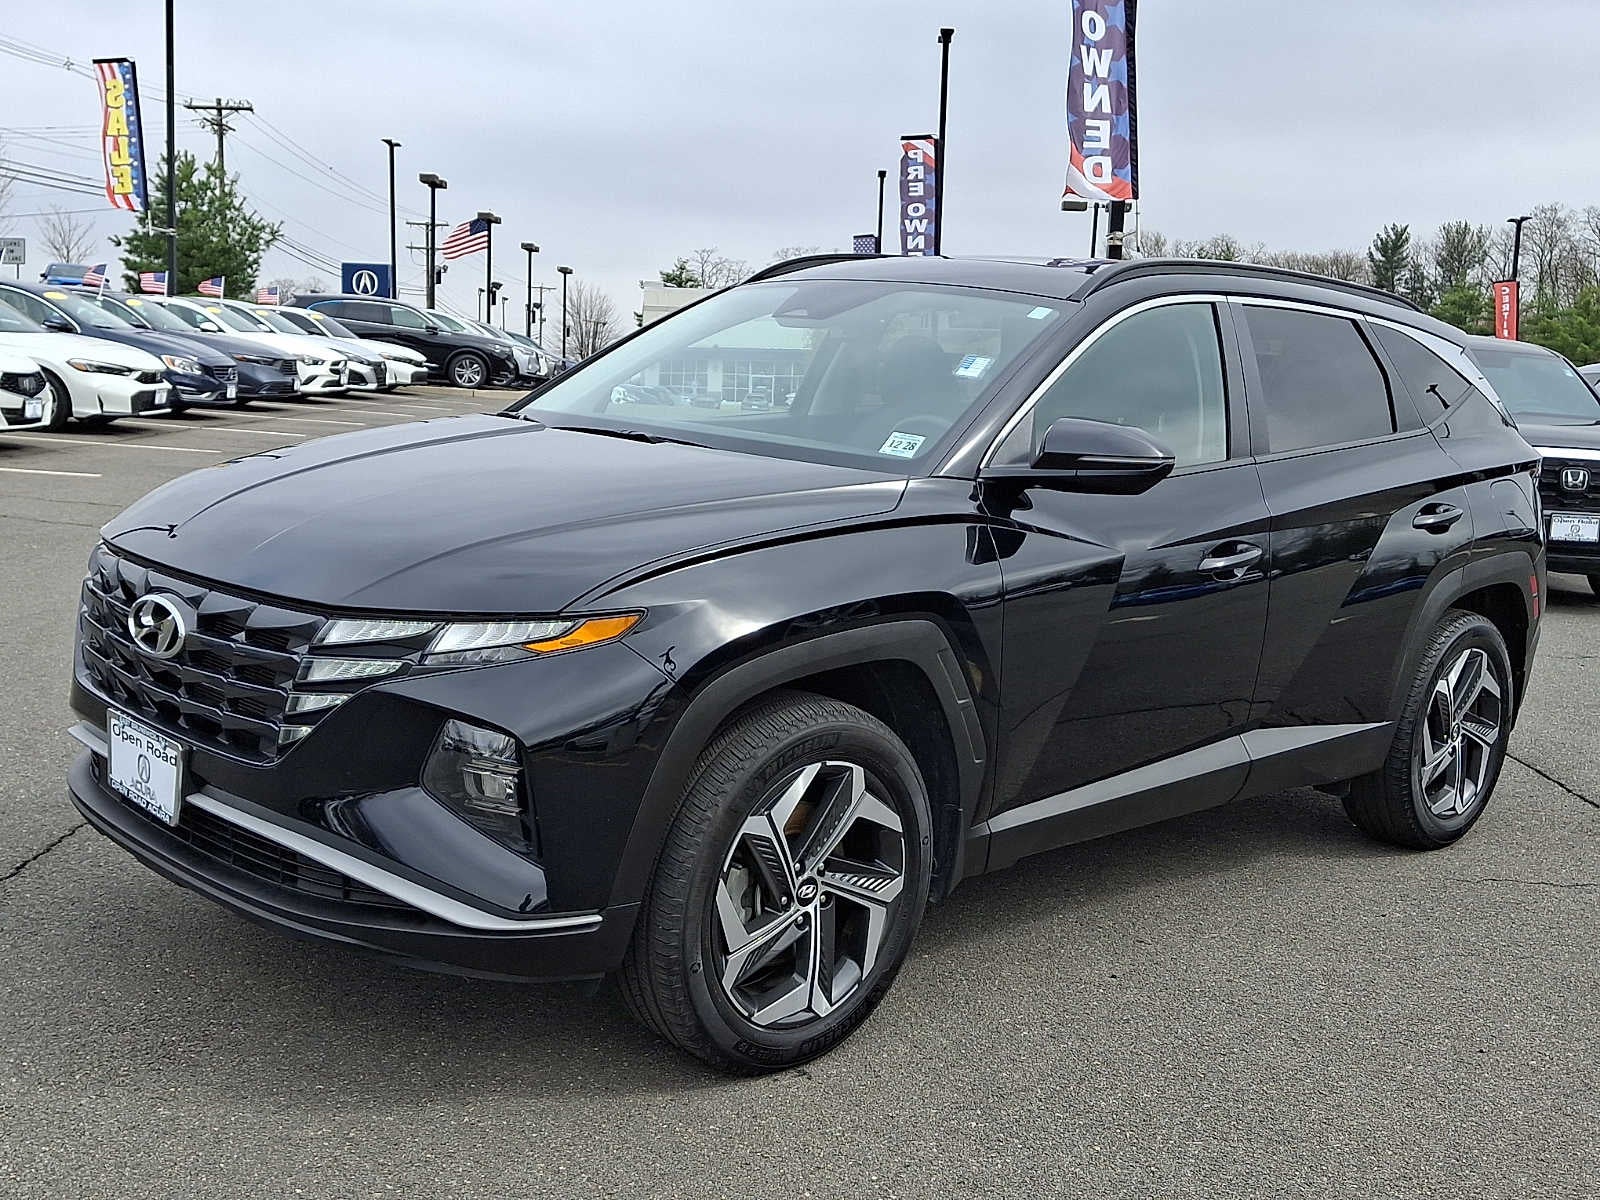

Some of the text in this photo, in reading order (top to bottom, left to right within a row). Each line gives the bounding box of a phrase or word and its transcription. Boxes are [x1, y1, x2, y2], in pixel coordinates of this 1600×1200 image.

[888, 440, 917, 451] 12 28
[113, 723, 142, 749] Open
[146, 740, 177, 766] Road
[111, 779, 170, 825] OPEN ROAD ACURA
